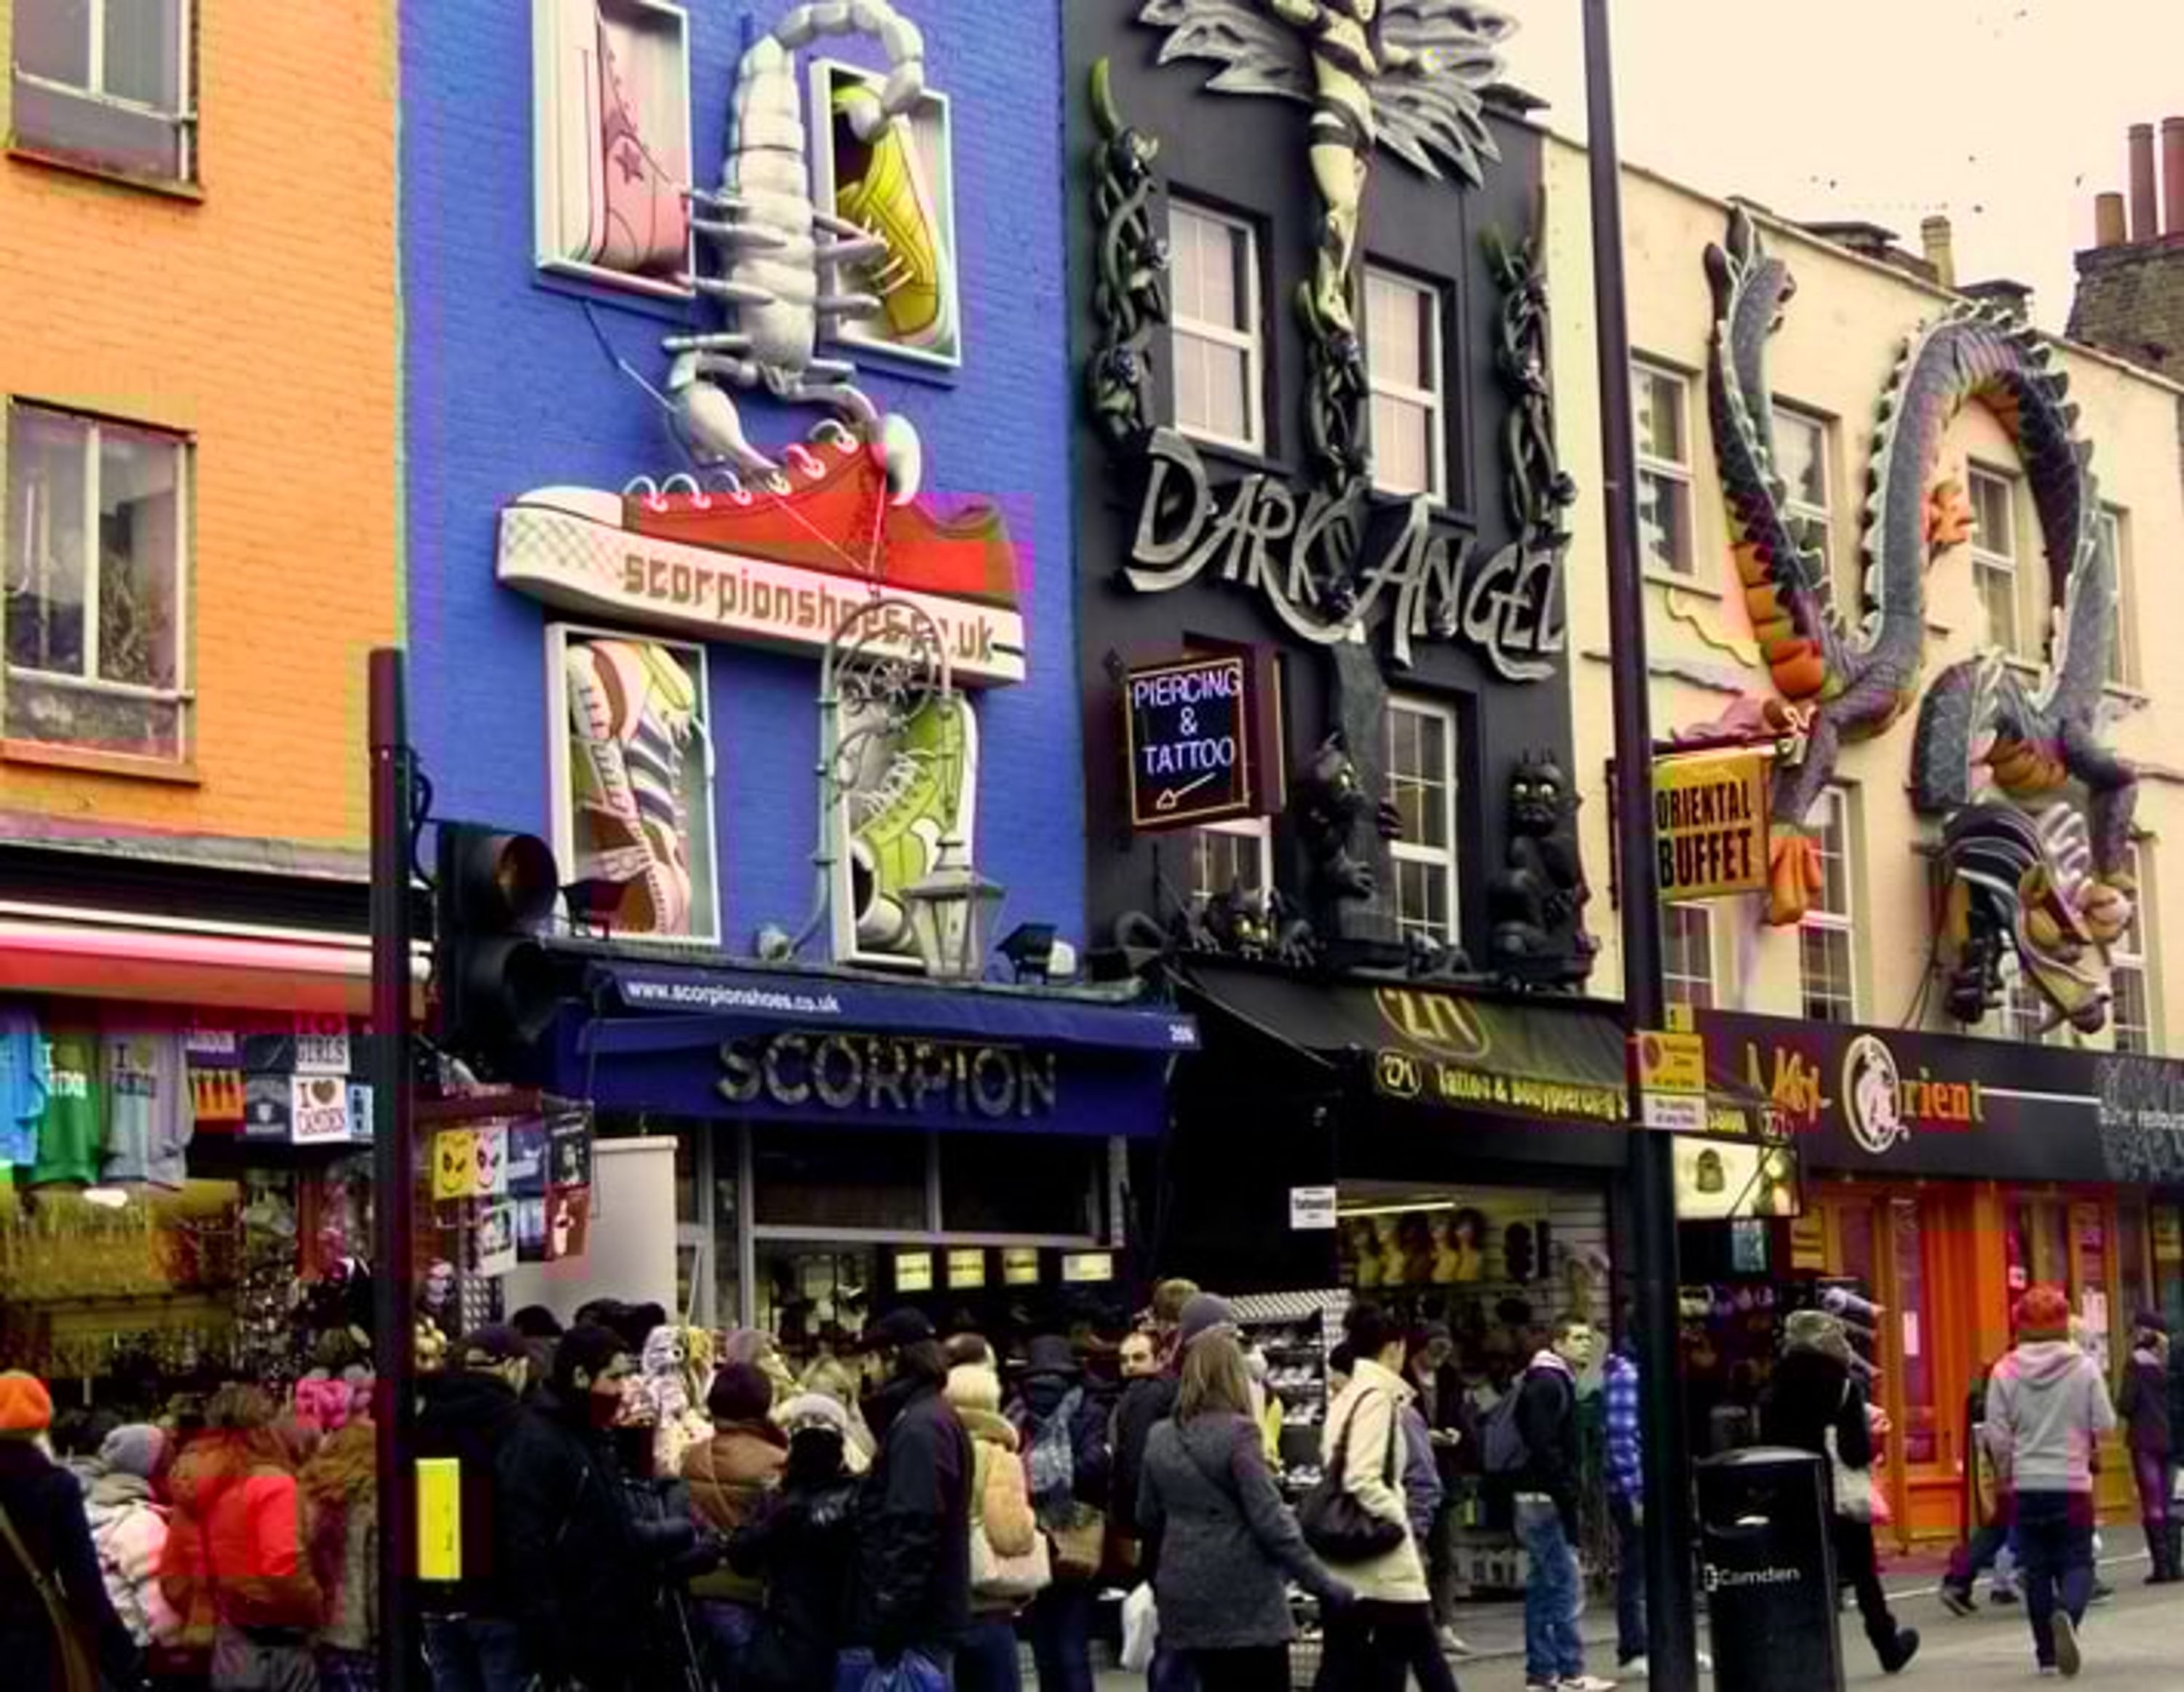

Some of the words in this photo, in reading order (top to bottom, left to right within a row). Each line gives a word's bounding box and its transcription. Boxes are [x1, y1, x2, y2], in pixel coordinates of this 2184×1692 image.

[1125, 426, 1366, 644] DARK
[1351, 492, 1567, 680] ANGEL
[1133, 665, 1241, 708] PIERCING
[1180, 706, 1199, 736] &
[1142, 736, 1235, 775] TATTOO
[1655, 779, 1751, 831] ORIENTAL
[1657, 827, 1751, 889] BUFFET
[626, 981, 841, 1013] www.scorpionshoes.co.uk
[717, 1030, 1057, 1118] SCORPION
